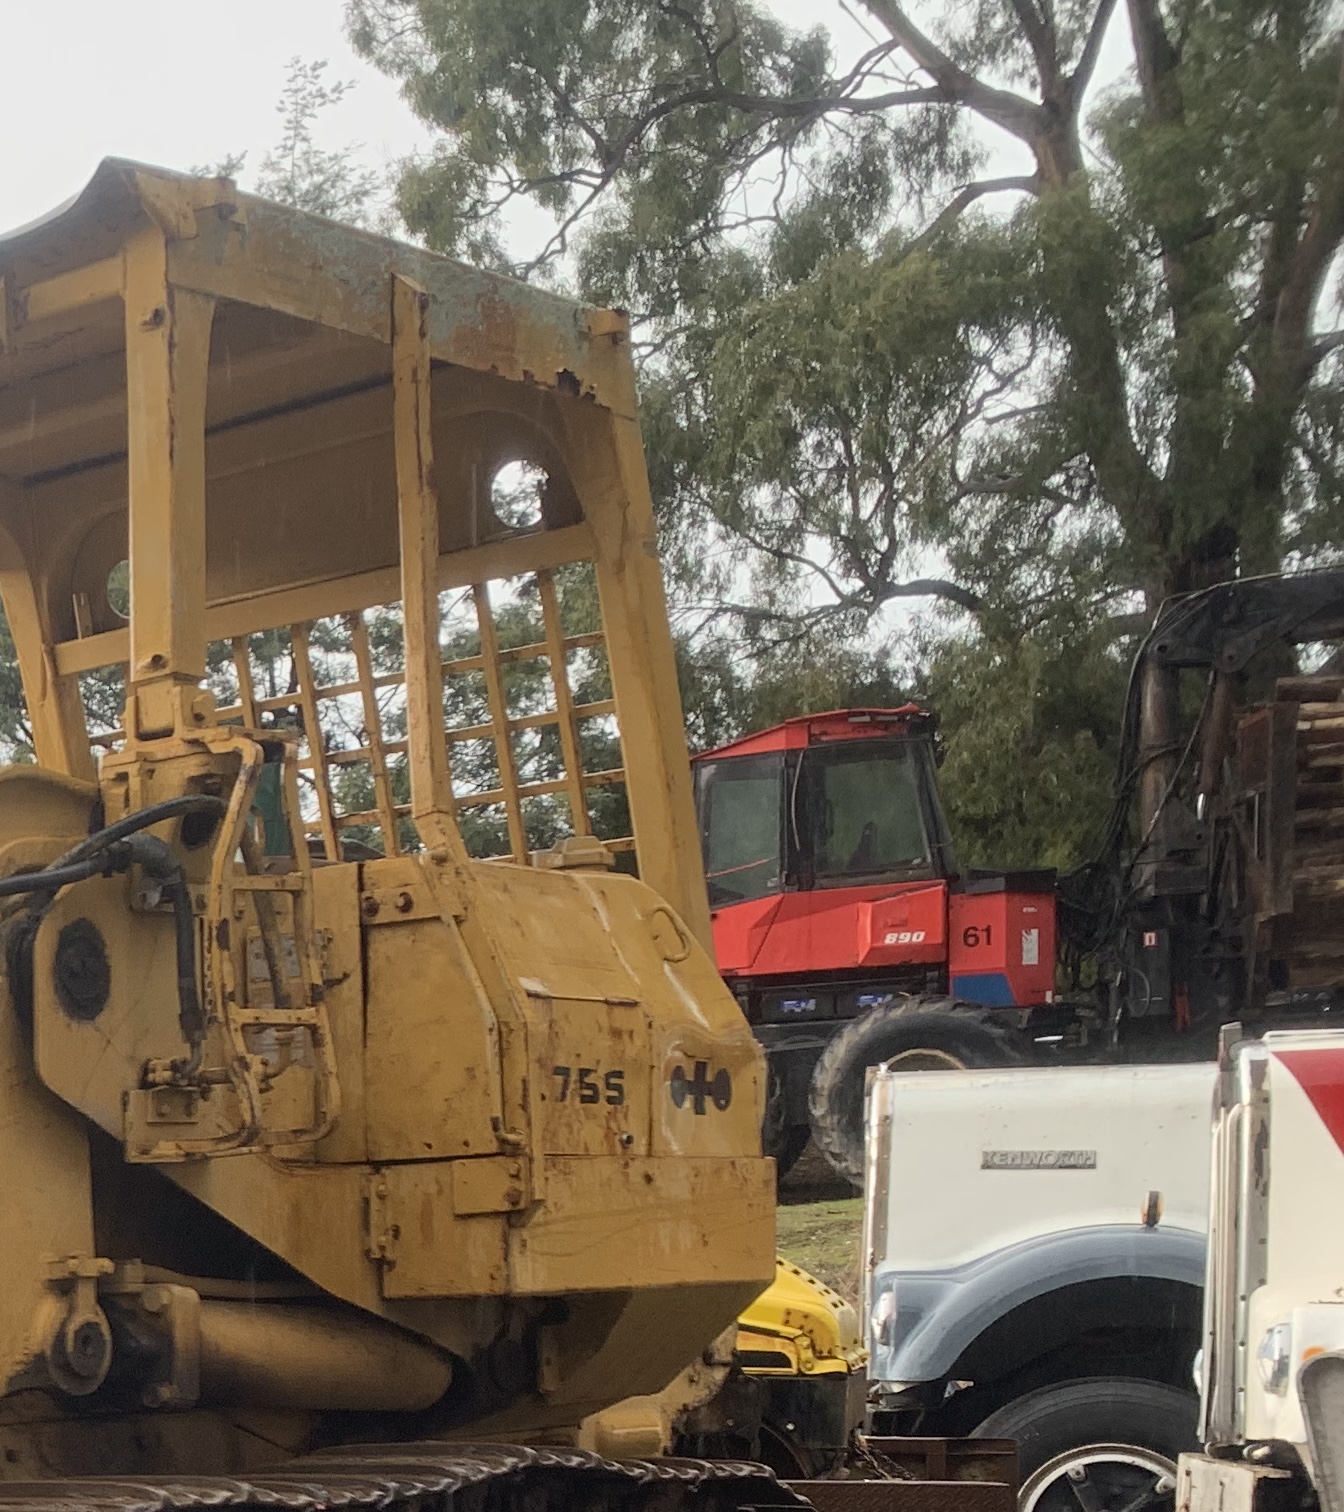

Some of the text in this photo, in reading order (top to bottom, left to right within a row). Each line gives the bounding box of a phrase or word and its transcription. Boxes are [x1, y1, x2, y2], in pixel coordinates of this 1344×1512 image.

[884, 931, 926, 944] 890
[963, 925, 992, 947] 61
[982, 1150, 1097, 1166] KENWORTH
